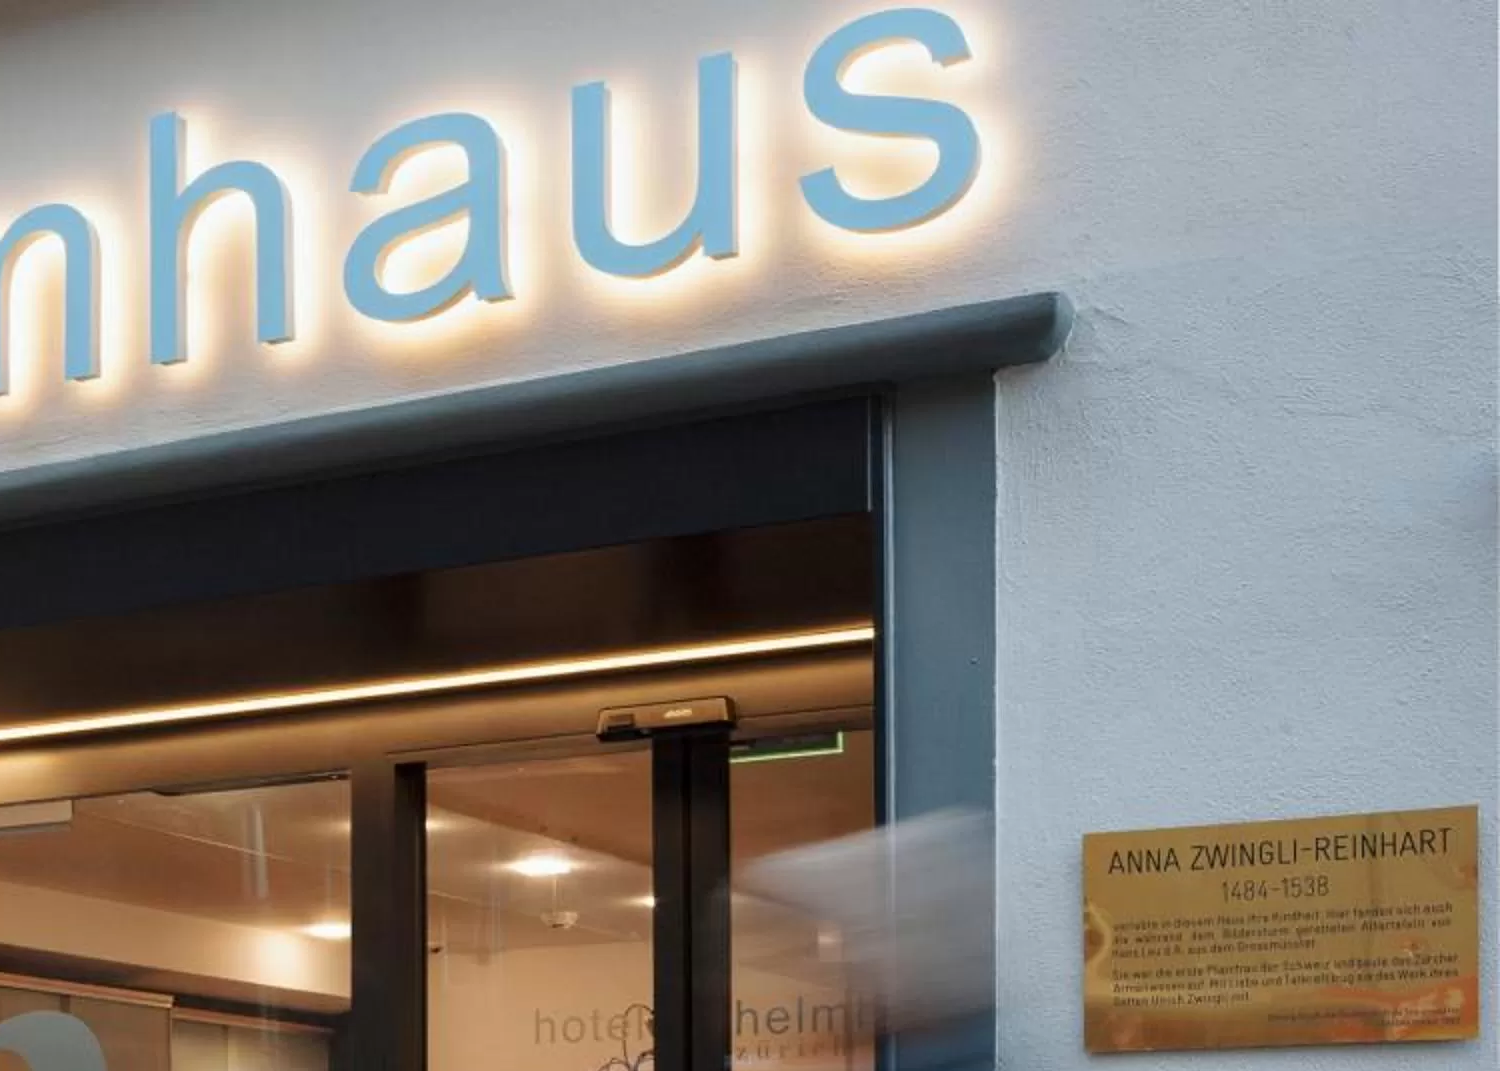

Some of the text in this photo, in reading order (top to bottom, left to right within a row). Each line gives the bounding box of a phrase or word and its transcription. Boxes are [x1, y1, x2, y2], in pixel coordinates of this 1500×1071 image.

[1108, 827, 1453, 875] ANNA ZWINGLI-REINHART
[1221, 875, 1330, 903] 1484-1538
[534, 1005, 645, 1046] hotel
